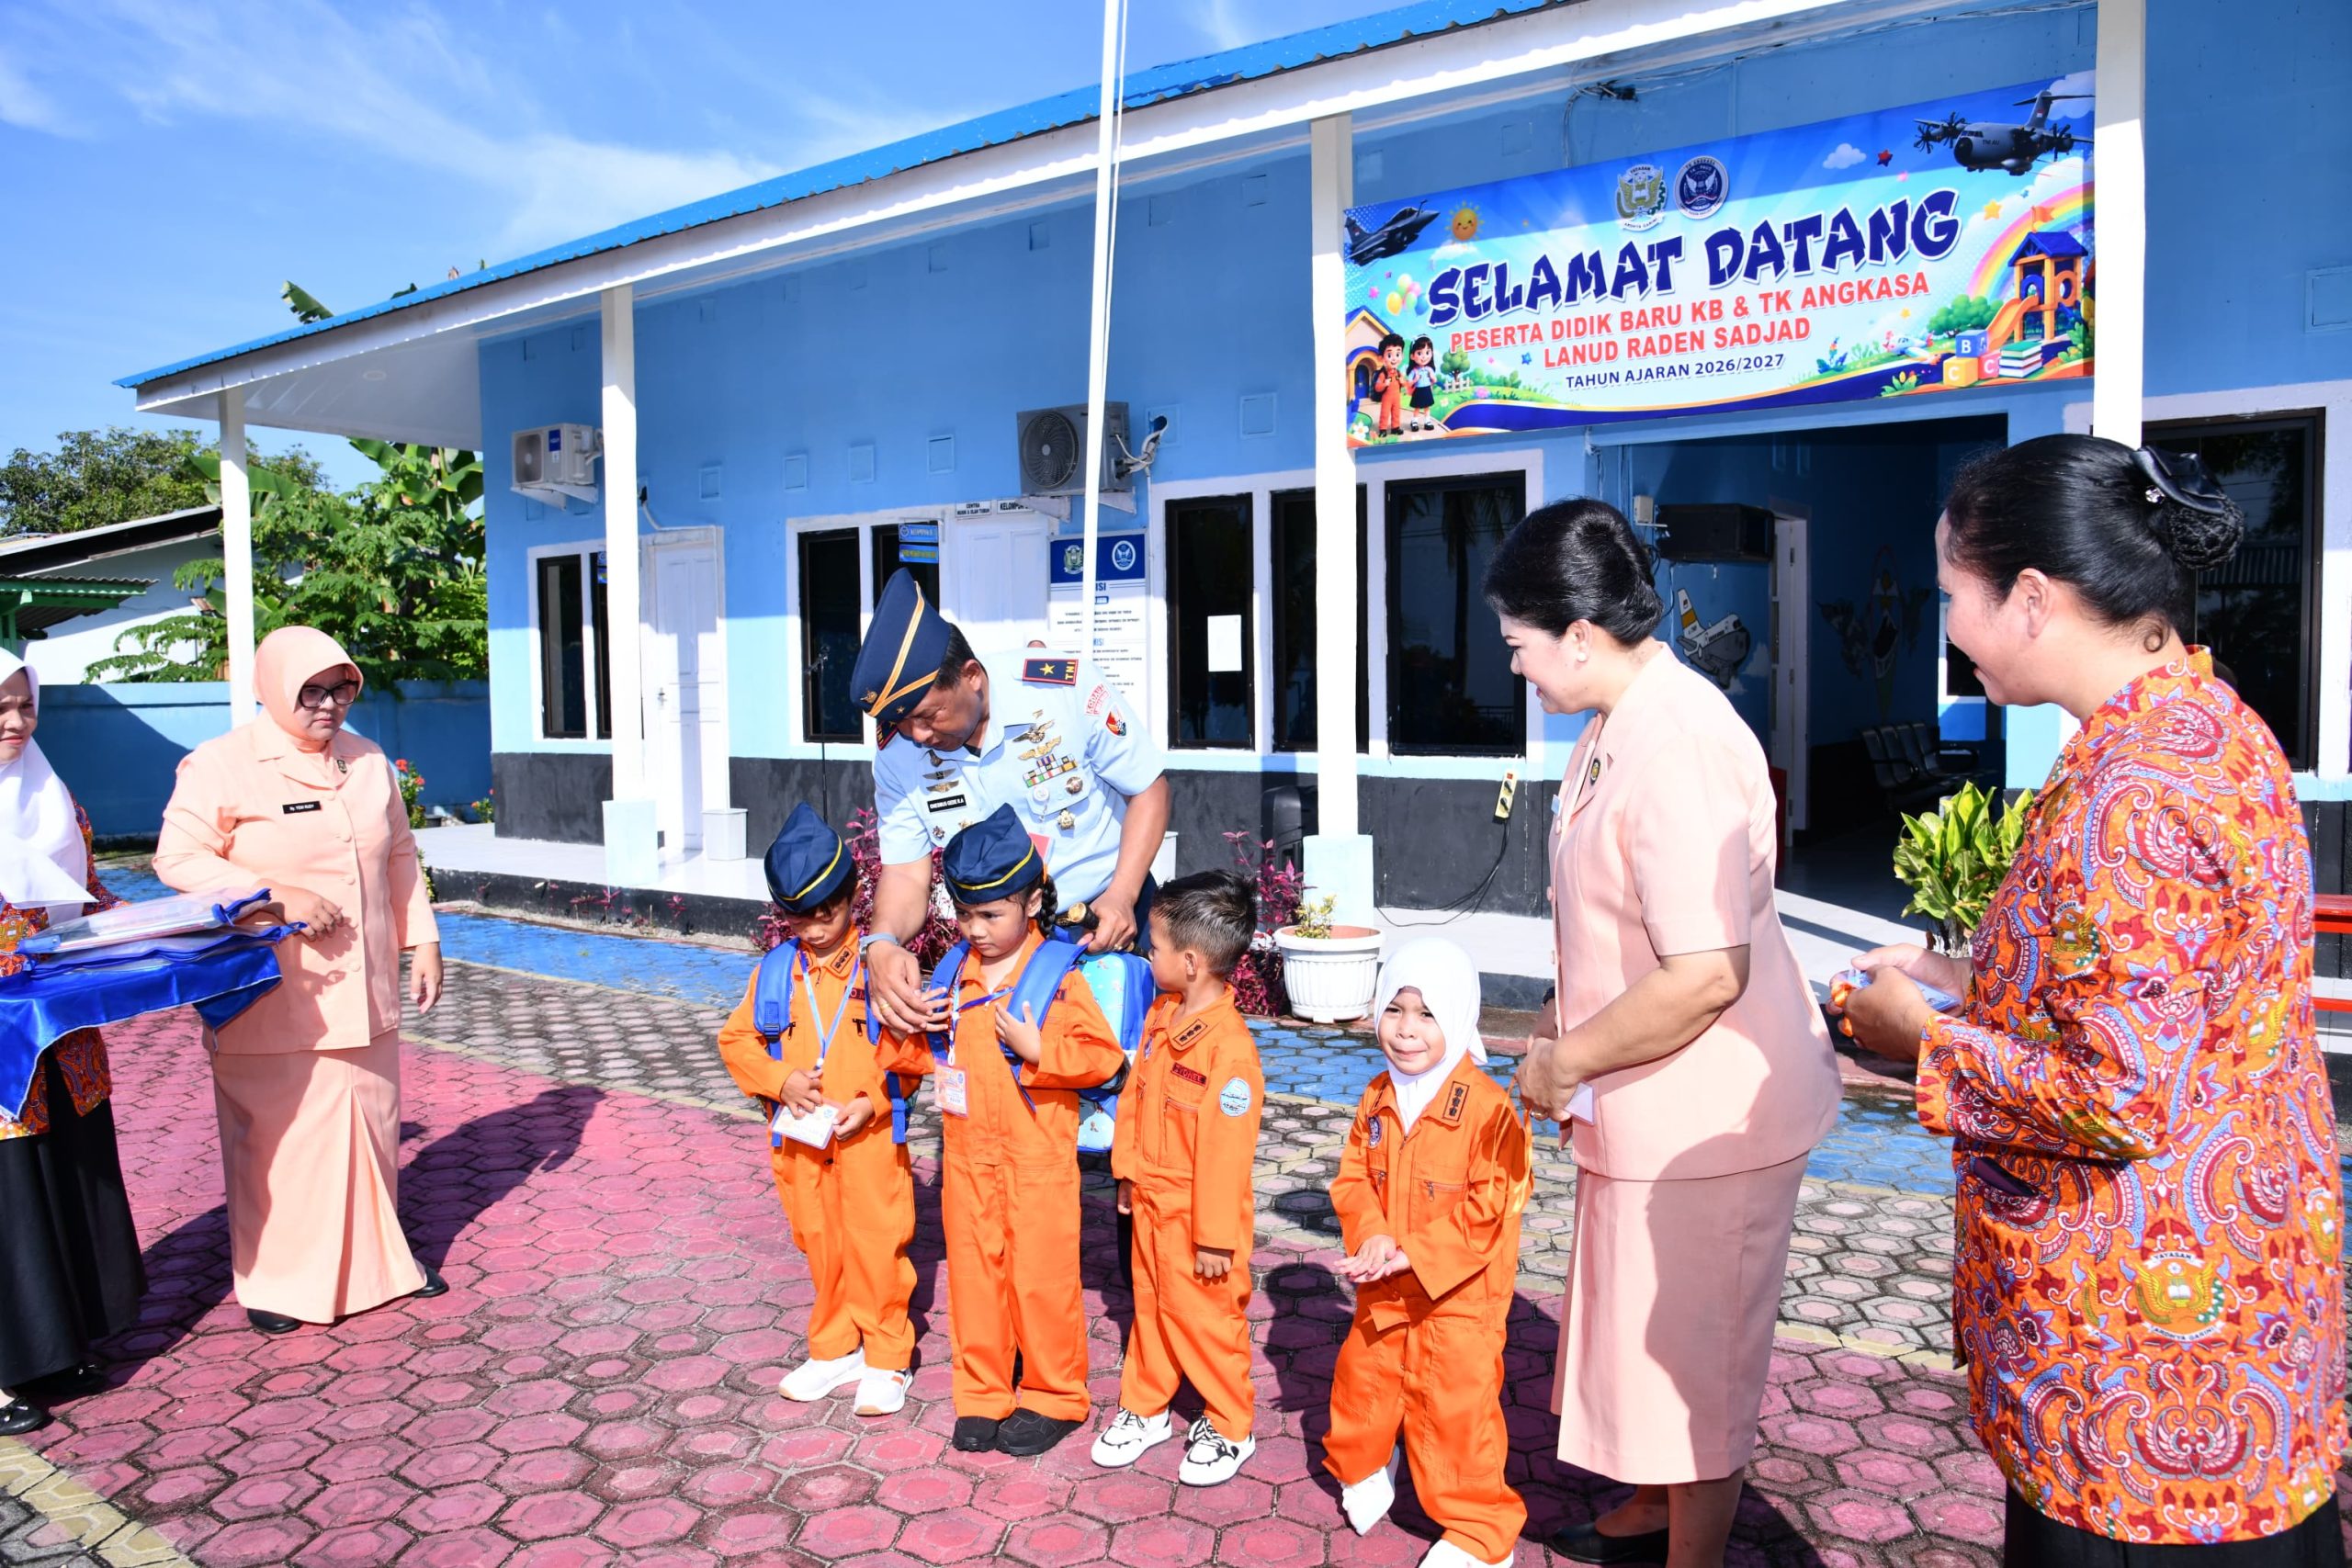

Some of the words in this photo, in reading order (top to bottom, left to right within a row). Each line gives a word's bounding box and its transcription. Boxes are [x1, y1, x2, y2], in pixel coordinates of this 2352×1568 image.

[1430, 235, 1682, 324] SELAMAT
[1704, 190, 1959, 286] DATANG
[1452, 323, 1543, 352] PESERTA
[1552, 313, 1611, 341] DIDIK
[1621, 304, 1681, 332] BARU
[1691, 299, 1724, 323] KB
[1734, 297, 1749, 317] &
[1758, 290, 1792, 313] TK
[1801, 272, 1928, 309] ANGKASA
[1544, 341, 1618, 367] LANUD
[1627, 330, 1704, 358] RADEN
[1714, 317, 1810, 348] SADJAD
[1961, 339, 1972, 354] B
[1566, 372, 1621, 389] TAHUN
[1624, 364, 1690, 383] AJARAN
[1694, 354, 1784, 376] 2026/2027
[1948, 366, 1960, 381] C
[1984, 359, 1995, 374] C
[1065, 661, 1076, 680] TNI
